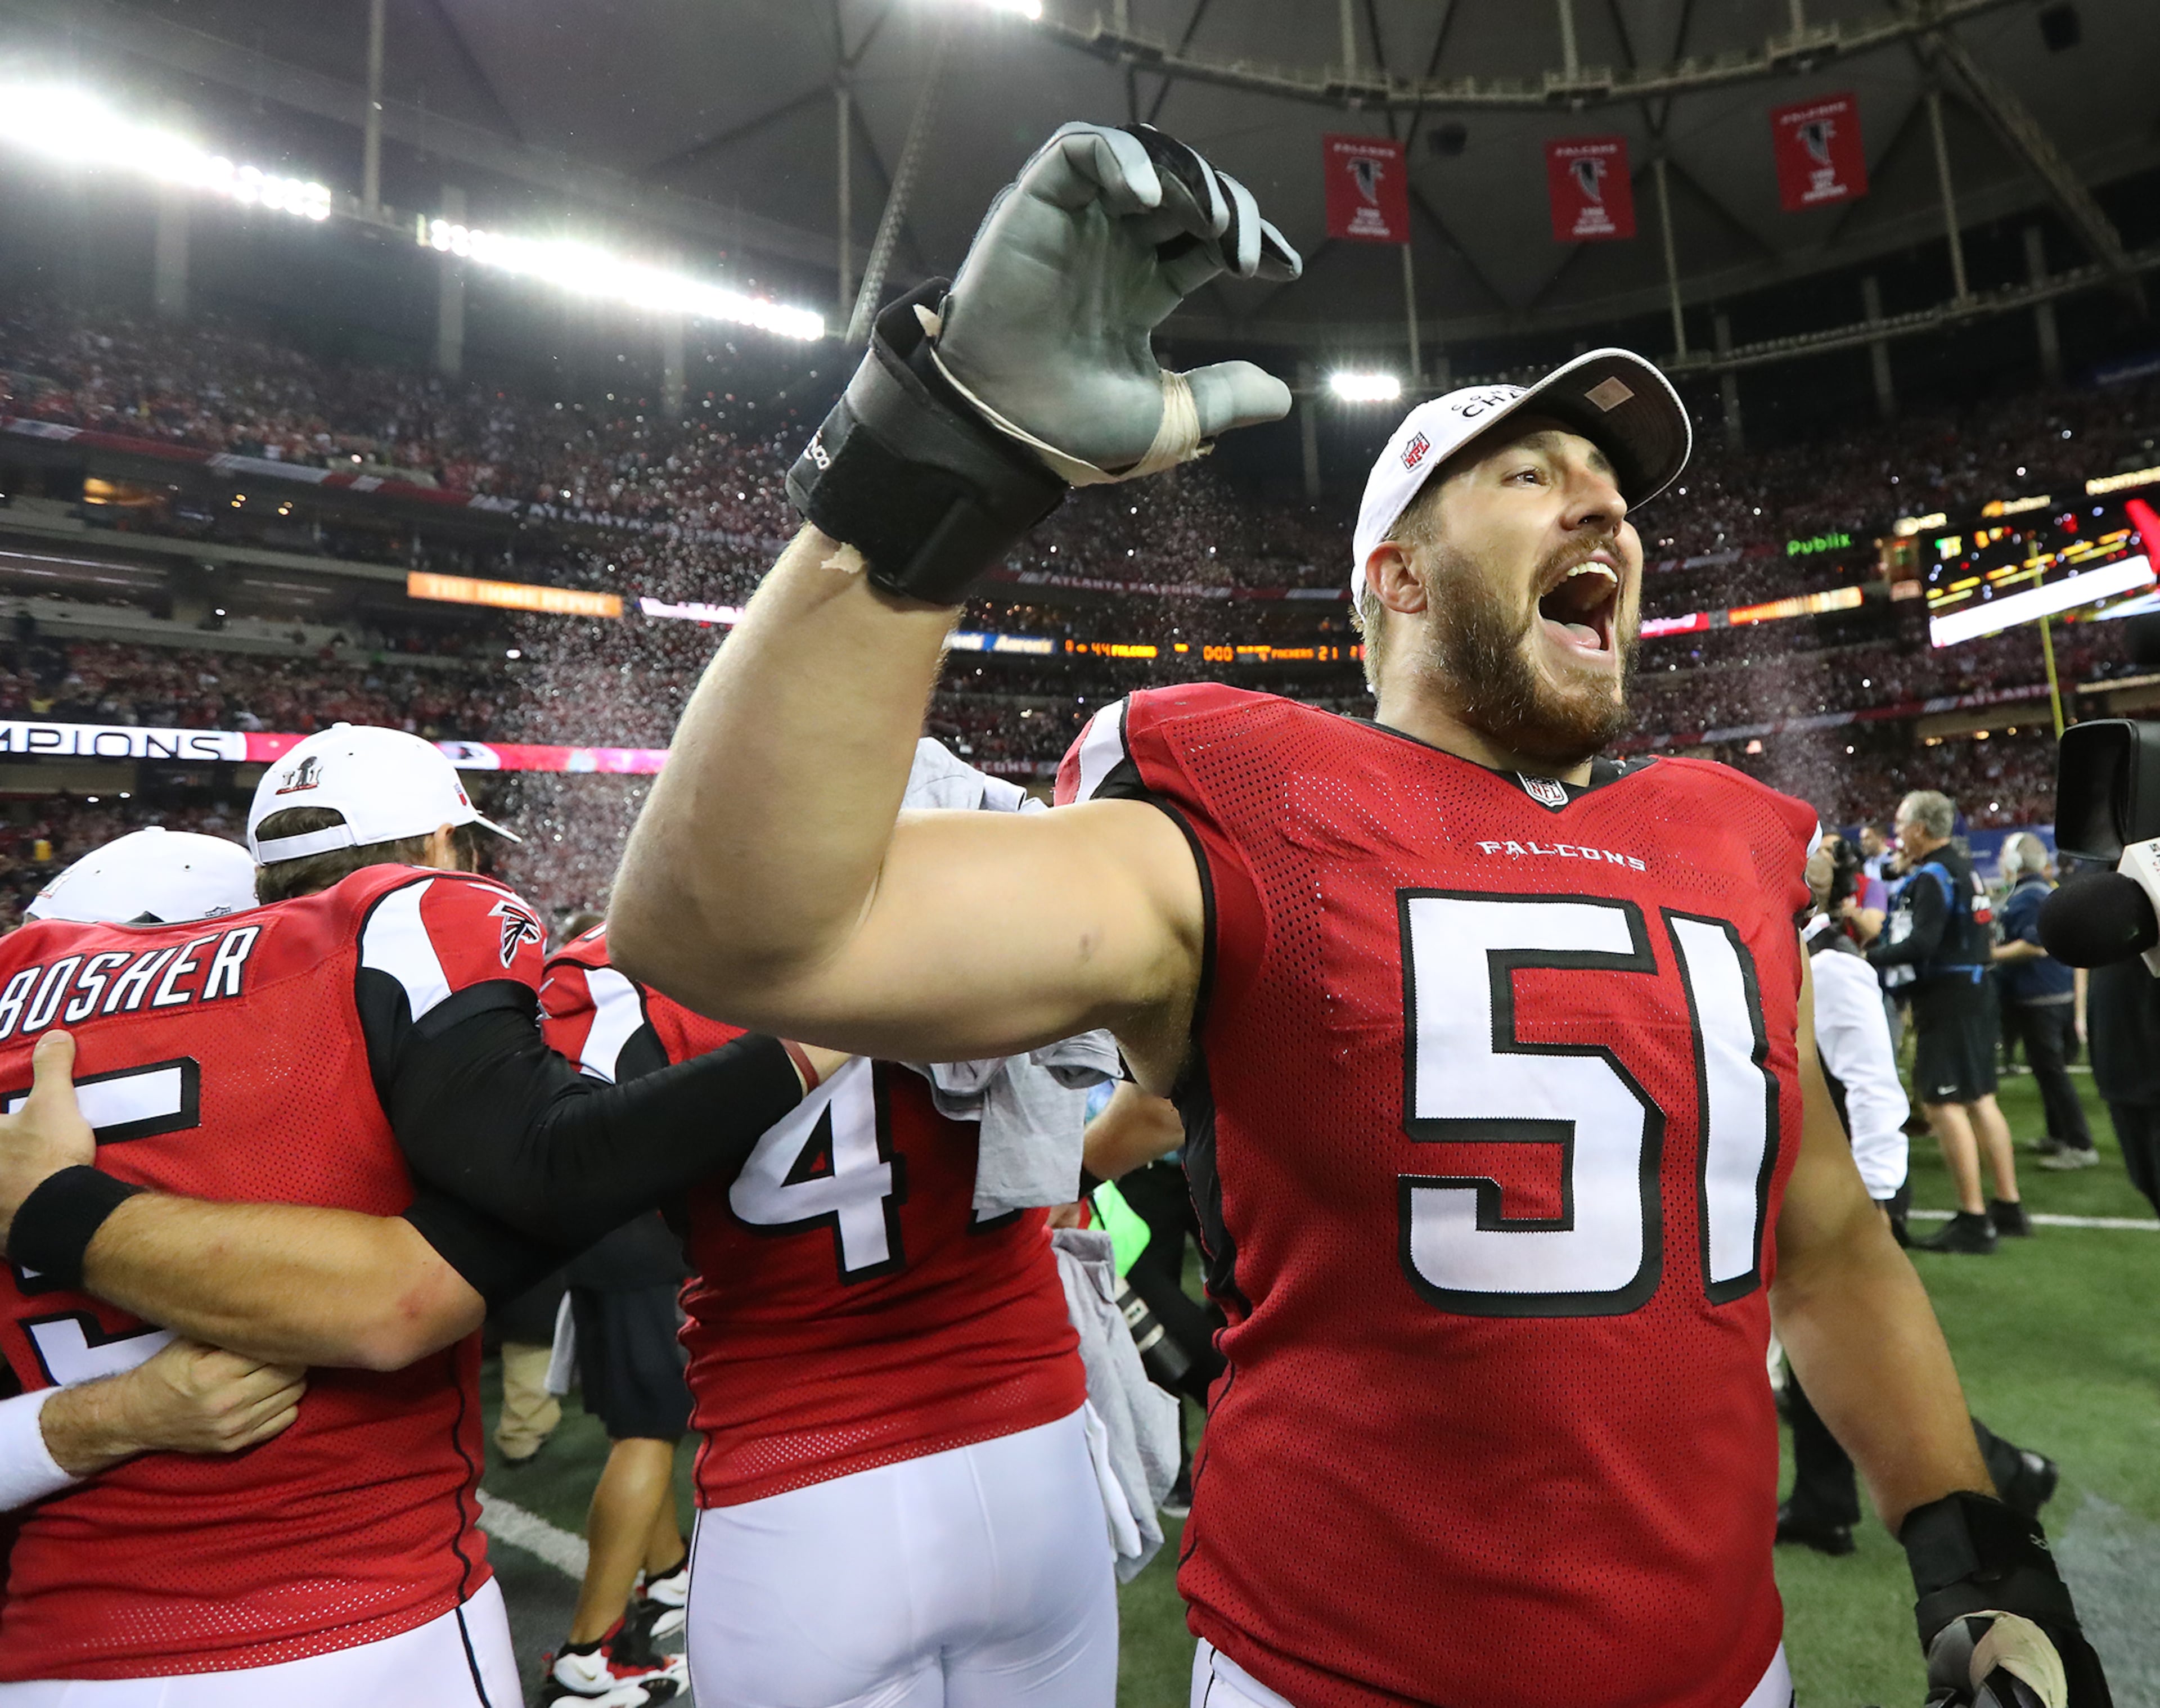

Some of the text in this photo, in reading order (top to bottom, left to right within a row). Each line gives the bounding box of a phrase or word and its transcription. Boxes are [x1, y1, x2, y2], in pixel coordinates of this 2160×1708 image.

[1405, 441, 1430, 468] NFL
[1786, 532, 1851, 556] Publix
[1050, 575, 1123, 589] ATLANTA
[1091, 642, 1110, 657] 44
[1110, 643, 1158, 659] FALCONS
[1529, 782, 1562, 800] NFL
[1475, 841, 1647, 872] FALCONS
[0, 925, 263, 1040] BOSHER
[1397, 889, 1780, 1318] 51
